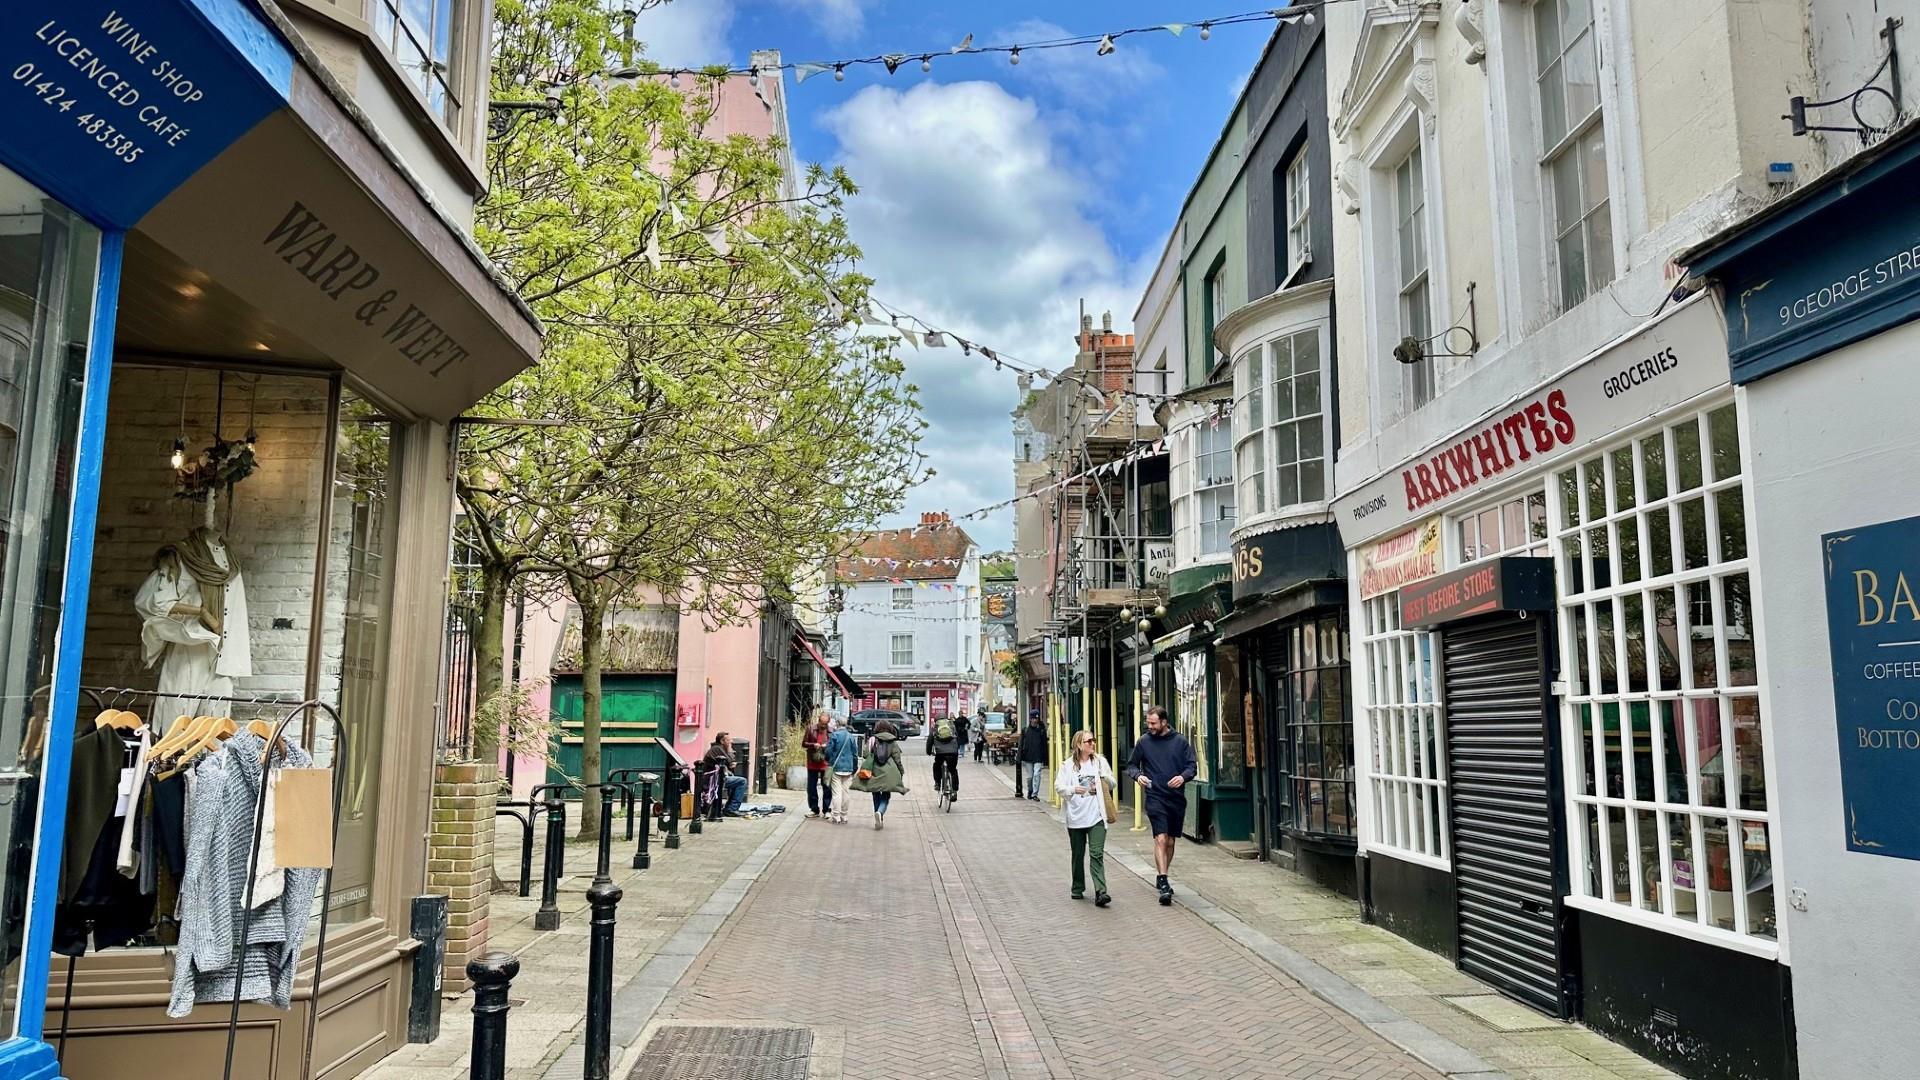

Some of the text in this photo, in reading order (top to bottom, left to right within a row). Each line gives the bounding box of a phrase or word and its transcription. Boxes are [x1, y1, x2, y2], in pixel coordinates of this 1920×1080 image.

[35, 20, 190, 147] LICENCED CAFÉ
[101, 10, 204, 103] WINE SHOP
[12, 63, 144, 163] 01424 483585
[262, 200, 470, 379] WARP & WEFT
[1779, 305, 1791, 326] 9
[1793, 268, 1872, 319] GEORGE
[1353, 346, 1678, 521] PROVISIONS ARKWHITES GROCERIES
[1149, 546, 1174, 560] Anti
[1404, 566, 1496, 624] BEST BEFORE STORE
[1853, 567, 1920, 627] BA
[1863, 661, 1920, 680] COFFEE
